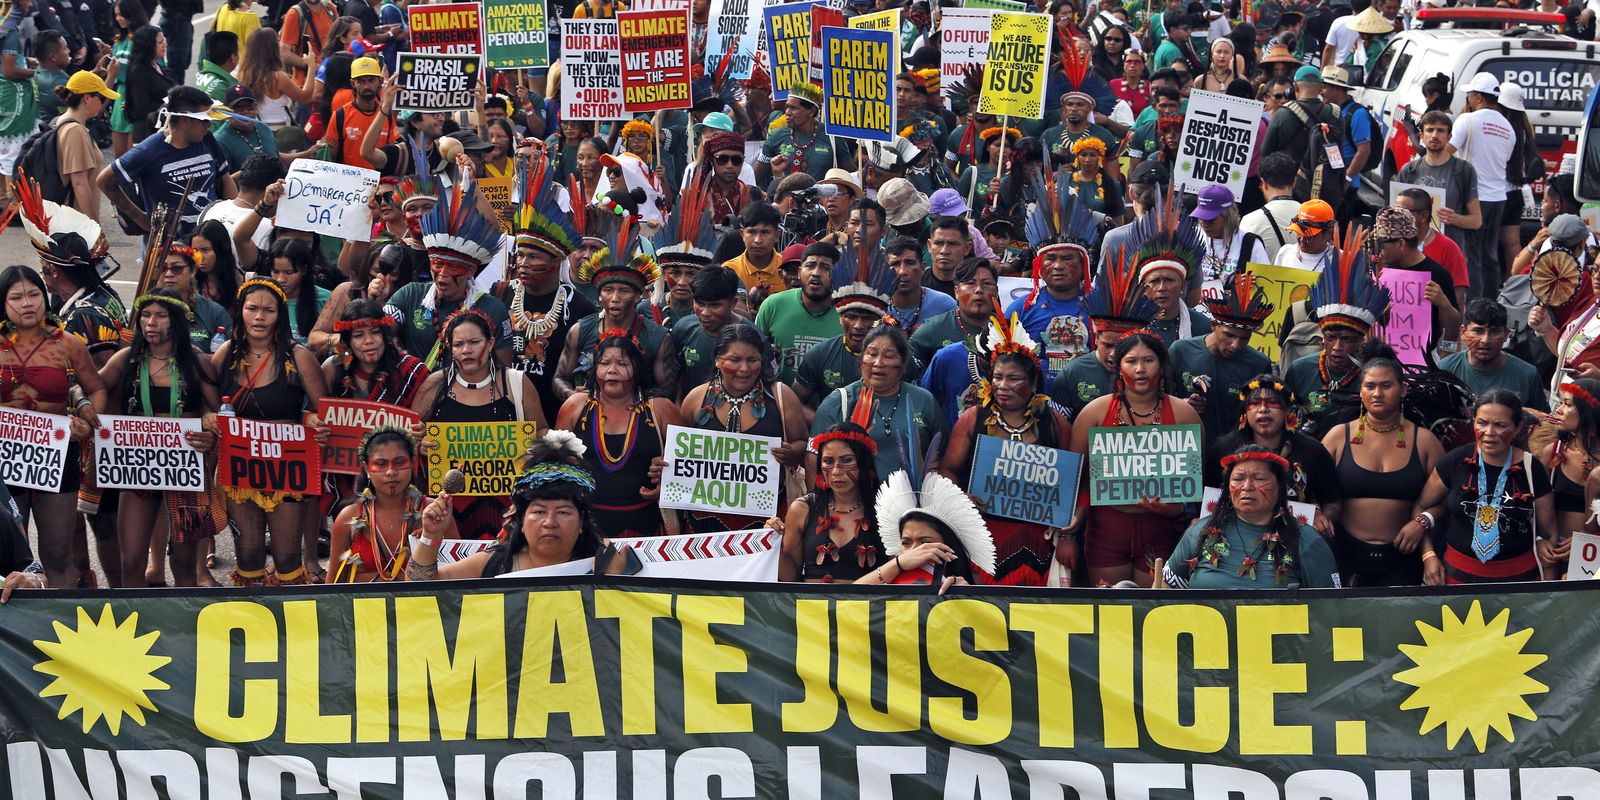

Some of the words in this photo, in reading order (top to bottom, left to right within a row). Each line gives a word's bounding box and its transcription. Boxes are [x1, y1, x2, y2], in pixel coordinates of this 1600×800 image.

[721, 0, 749, 16] NADA
[411, 10, 478, 31] CLIMATE
[487, 17, 524, 33] LIVRE
[526, 16, 544, 31] DE
[565, 23, 591, 34] THEY
[620, 17, 686, 38] CLIMATE
[717, 16, 749, 35] SOBRE
[771, 11, 810, 40] PARE
[877, 16, 890, 28] THE
[413, 30, 478, 44] EMERGENCY
[565, 35, 591, 50] OUR
[594, 35, 618, 50] LAN
[622, 34, 686, 50] EMERGENCY
[944, 30, 952, 42] O
[955, 30, 989, 43] FUTUR
[1016, 35, 1032, 43] ARE
[584, 51, 608, 63] NOW
[624, 52, 650, 71] WE
[654, 49, 684, 69] ARE
[775, 39, 797, 65] DE
[830, 38, 888, 70] PAREM
[987, 42, 1045, 64] NATURE
[414, 59, 464, 76] BRASIL
[566, 64, 594, 76] THEY
[595, 64, 620, 75] WAN
[645, 70, 664, 83] THE
[990, 61, 1003, 69] THE
[1005, 62, 1039, 72] ANSWER
[406, 74, 447, 91] LIVRE
[450, 76, 468, 91] DE
[572, 76, 585, 88] TO
[588, 76, 620, 88] STEAL
[831, 67, 851, 97] DE
[854, 70, 887, 101] NOS
[989, 69, 1007, 91] IS
[1007, 70, 1034, 94] US
[1504, 68, 1595, 87] POLÍCIA
[584, 89, 609, 103] OUR
[625, 82, 688, 104] ANSWER
[570, 103, 623, 118] HISTORY
[829, 97, 890, 133] MATAR!
[1218, 109, 1228, 124] A
[1188, 119, 1251, 145] RESPOSTA
[1183, 135, 1249, 166] SOMOS
[1192, 158, 1230, 184] NÓS
[0, 411, 53, 430] ERGÊNCIA
[113, 419, 181, 434] EMERGÊNCIA
[324, 405, 413, 432] AMAZÔNIA
[114, 432, 182, 448] CLIMÁTICA
[228, 418, 240, 436] O
[242, 419, 306, 441] FUTURO
[446, 425, 494, 442] CLIMA
[497, 424, 517, 441] DE
[250, 440, 260, 458] É
[261, 441, 282, 458] DO
[674, 432, 768, 465] SEMPRE
[1092, 427, 1198, 454] AMAZÔNIA
[99, 447, 111, 465] A
[114, 447, 200, 467] RESPOSTA
[1001, 440, 1058, 467] NOSSO
[99, 465, 161, 486] SOMOS
[165, 464, 201, 488] NÓS
[230, 455, 307, 491] POVO
[463, 459, 516, 477] AGORA
[674, 459, 768, 484] ESTIVEMOS
[993, 457, 1059, 486] FUTURO
[1103, 454, 1157, 477] LIVRE
[1161, 454, 1188, 475] DE
[469, 477, 520, 494] AGOR
[690, 479, 747, 508] AQUI
[984, 475, 1020, 498] NÃO
[1022, 481, 1061, 506] ESTÁ
[1096, 475, 1196, 501] PETRÓLEO
[1001, 497, 1054, 524] VENDA
[194, 589, 753, 744] CLIMATE
[781, 599, 1367, 755] JUSTICE:
